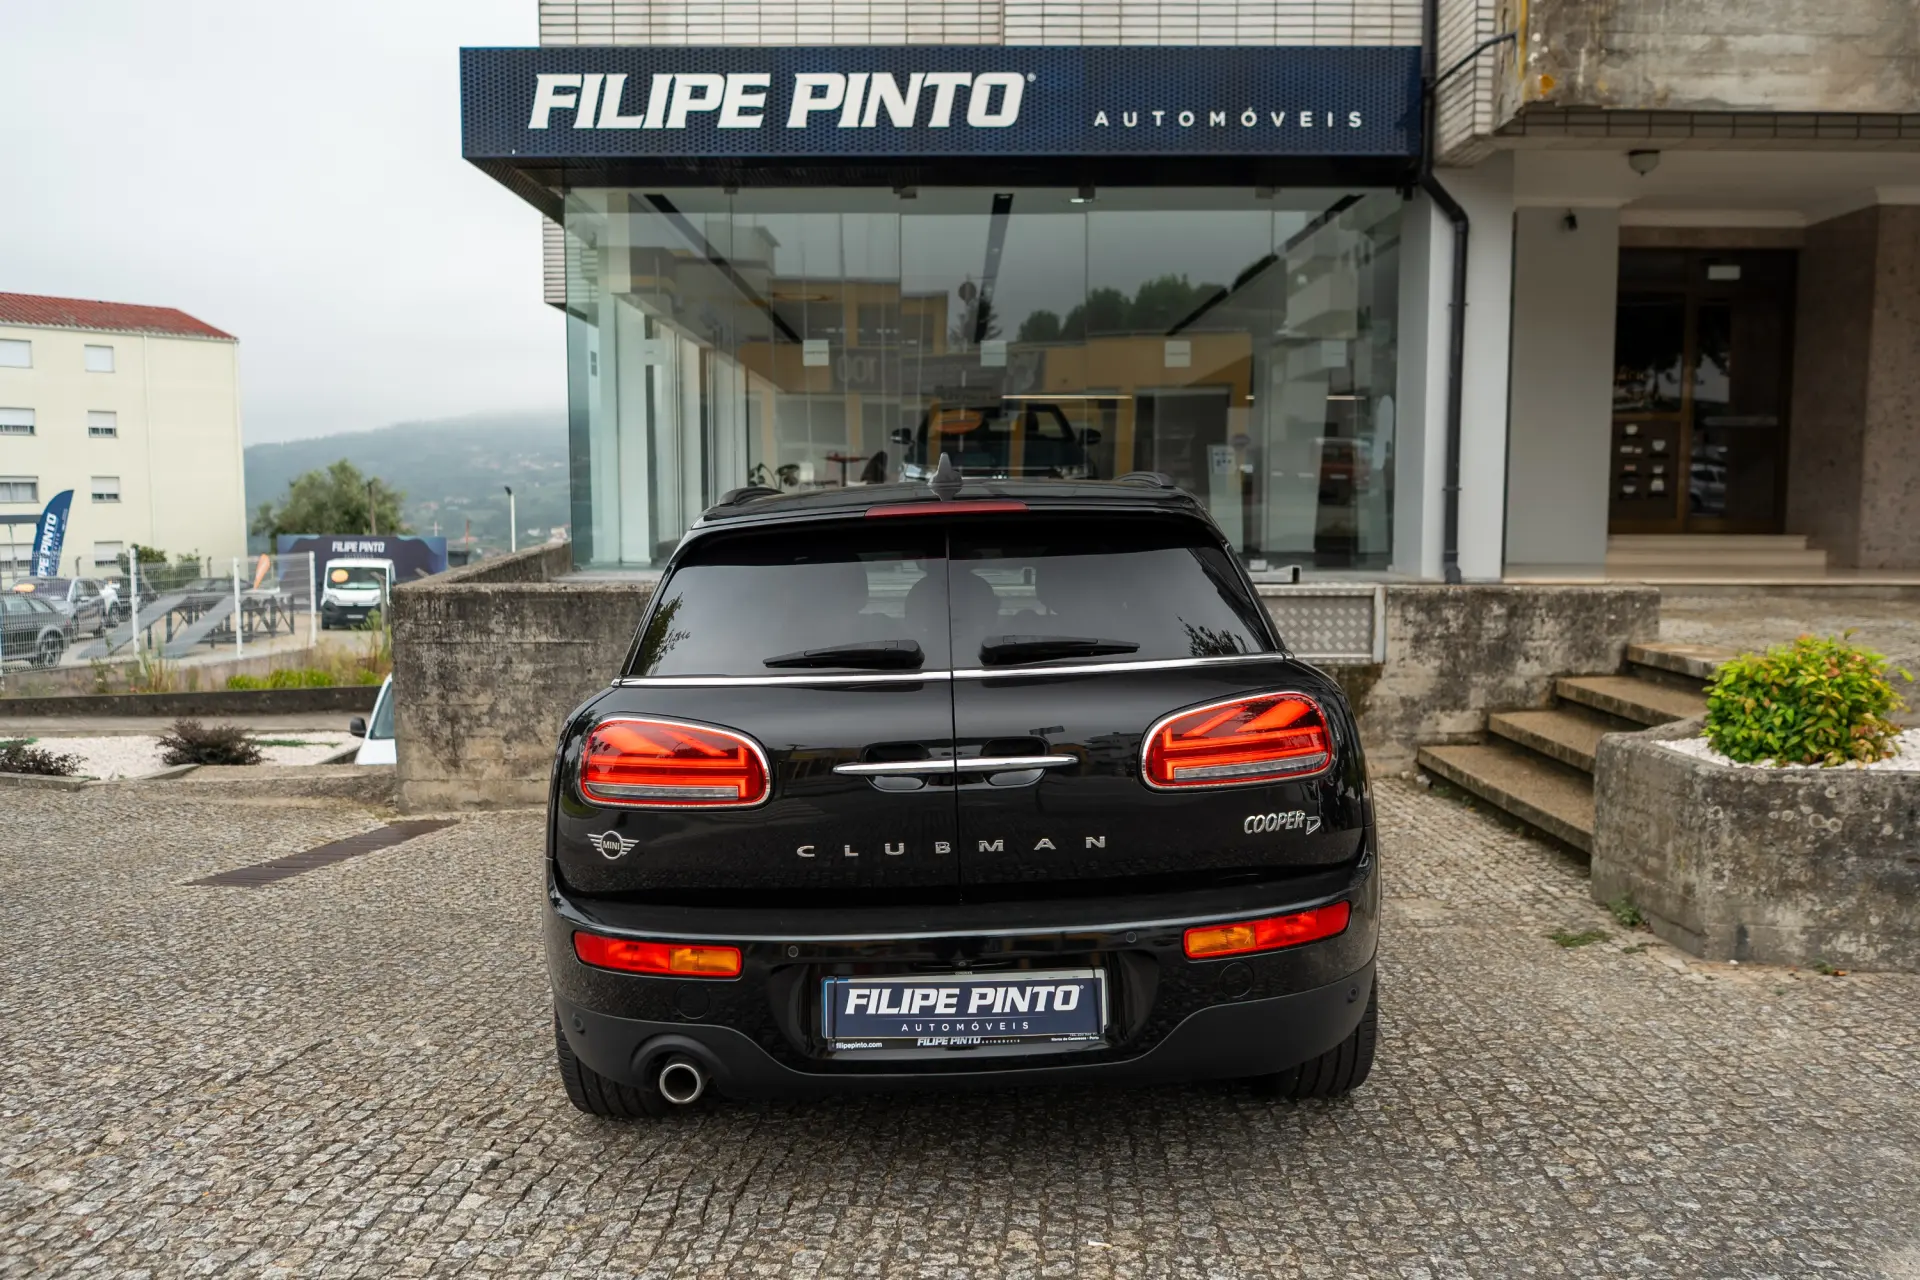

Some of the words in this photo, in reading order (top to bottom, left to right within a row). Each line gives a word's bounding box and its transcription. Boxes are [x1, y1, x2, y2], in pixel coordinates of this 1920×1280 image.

[528, 73, 771, 129] FILIPE
[786, 72, 1025, 128] PINTO
[1094, 107, 1362, 127] AUTOMÓVEIS
[40, 512, 57, 556] PINTO
[332, 541, 358, 552] FILIPE
[359, 541, 385, 553] PINTO
[1244, 810, 1306, 834] COOPER
[602, 841, 620, 850] MINI
[797, 836, 1106, 857] CLUBMAN
[845, 988, 960, 1015] FILIPE
[967, 985, 1081, 1014] PINTO
[901, 1021, 1030, 1032] AUTOMÓVEIS
[917, 1037, 949, 1046] FILIPE
[949, 1036, 981, 1045] PINTO
